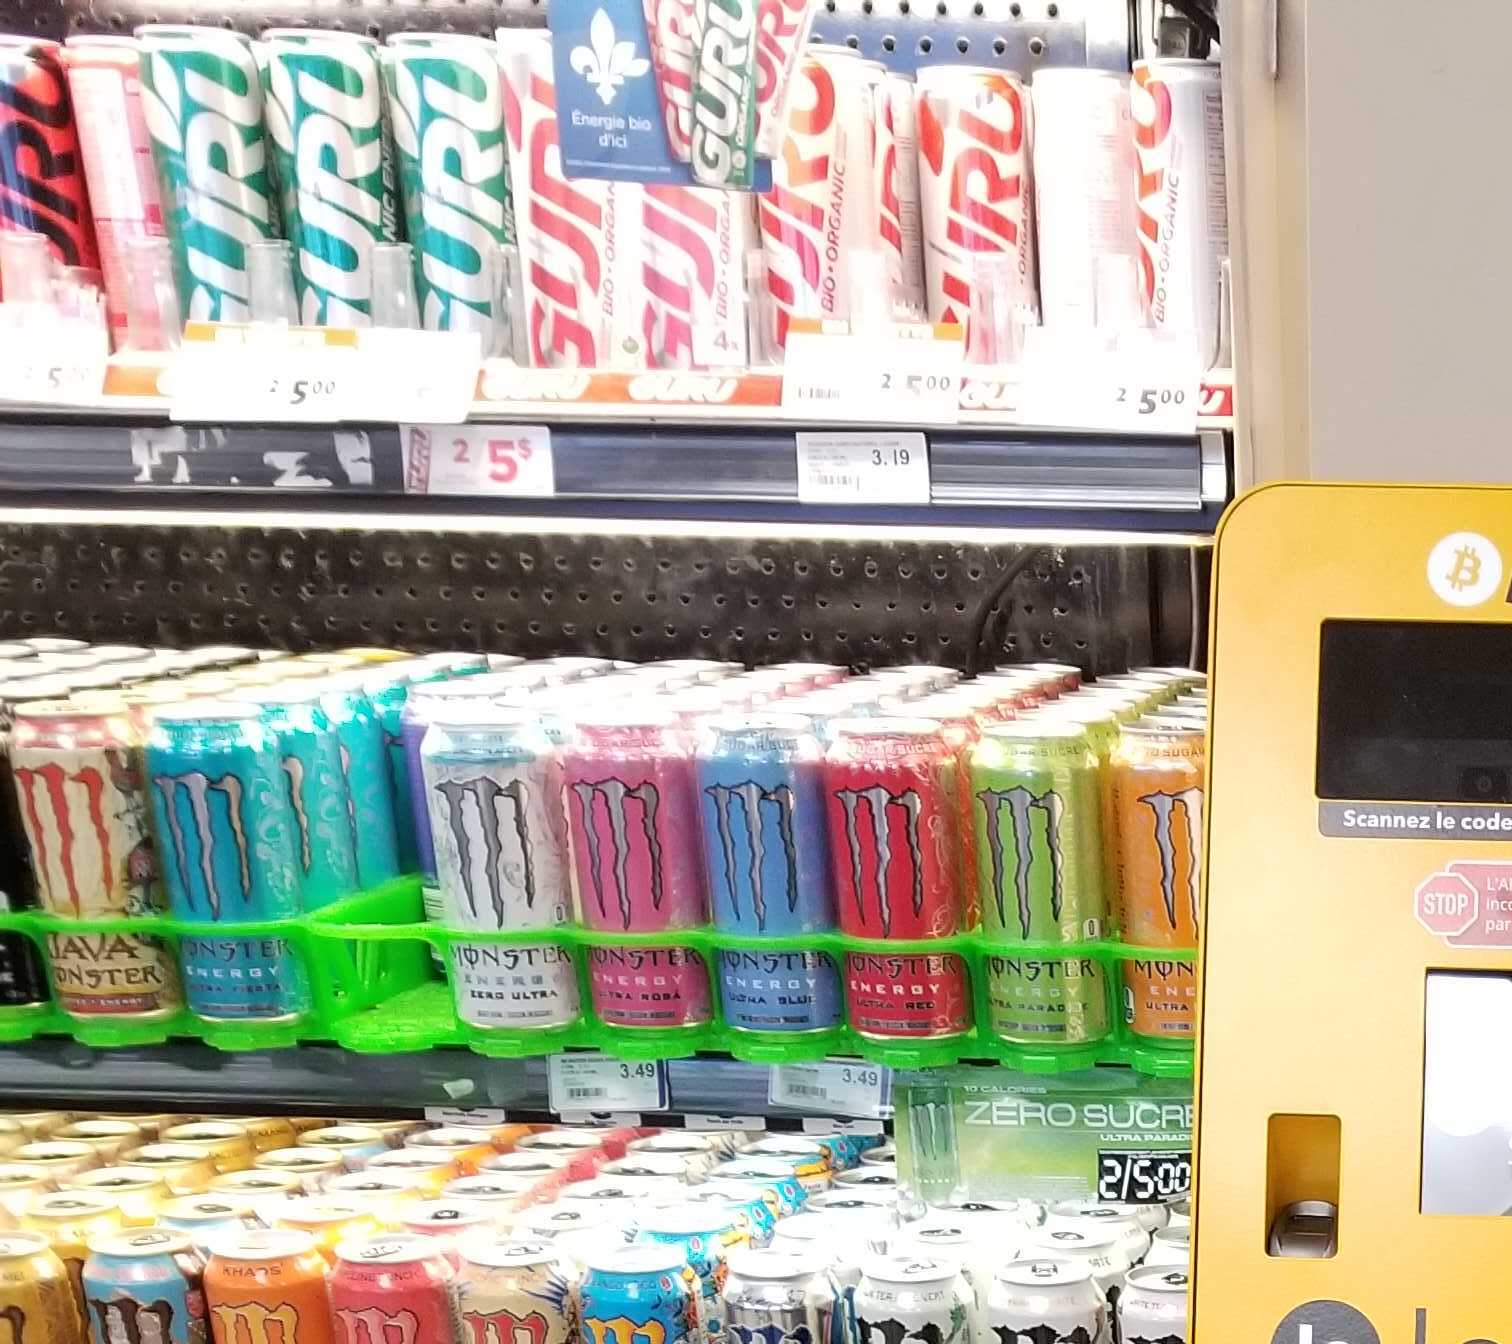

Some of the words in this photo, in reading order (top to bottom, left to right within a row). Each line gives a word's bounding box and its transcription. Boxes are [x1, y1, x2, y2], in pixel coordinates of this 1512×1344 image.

[571, 109, 626, 130] Énergie
[628, 116, 652, 132] bio
[598, 133, 628, 148] d'ici
[871, 449, 910, 467] 3.19
[1343, 810, 1430, 829] Scannez
[1436, 811, 1455, 830] le
[1461, 812, 1512, 831] code
[1423, 892, 1469, 916] STOP
[1485, 919, 1511, 934] par
[620, 1063, 655, 1079] 3.49
[842, 1068, 878, 1086] 3.49
[964, 1101, 1076, 1128] ZERO
